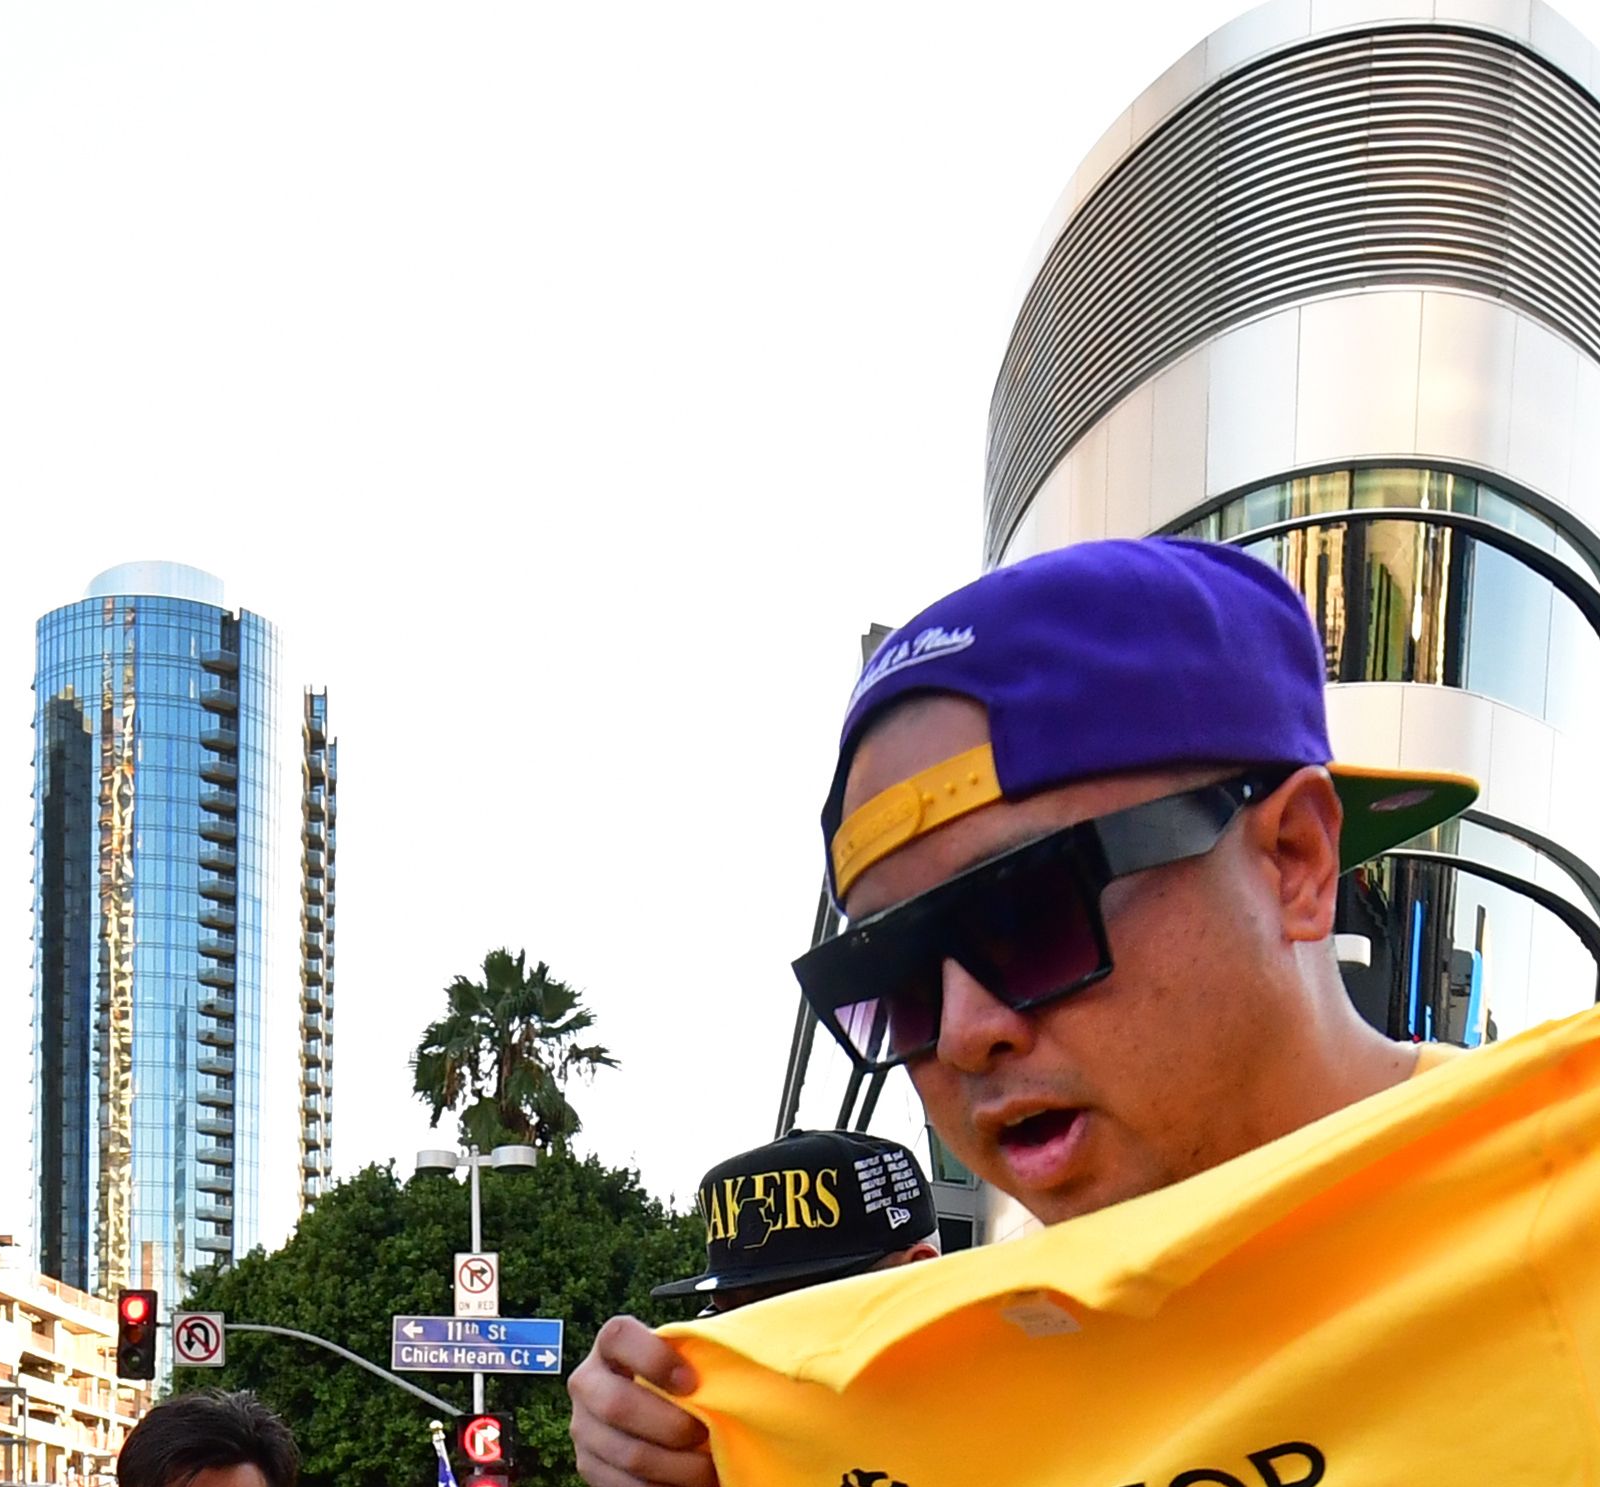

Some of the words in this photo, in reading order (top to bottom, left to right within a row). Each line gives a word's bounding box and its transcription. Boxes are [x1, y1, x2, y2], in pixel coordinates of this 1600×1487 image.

[458, 1302, 470, 1311] ON
[478, 1301, 494, 1311] RED
[447, 1321, 480, 1342] 11th
[488, 1324, 507, 1341] St
[401, 1346, 449, 1364] Chick
[453, 1348, 505, 1365] Hearn
[510, 1349, 530, 1366] Ct
